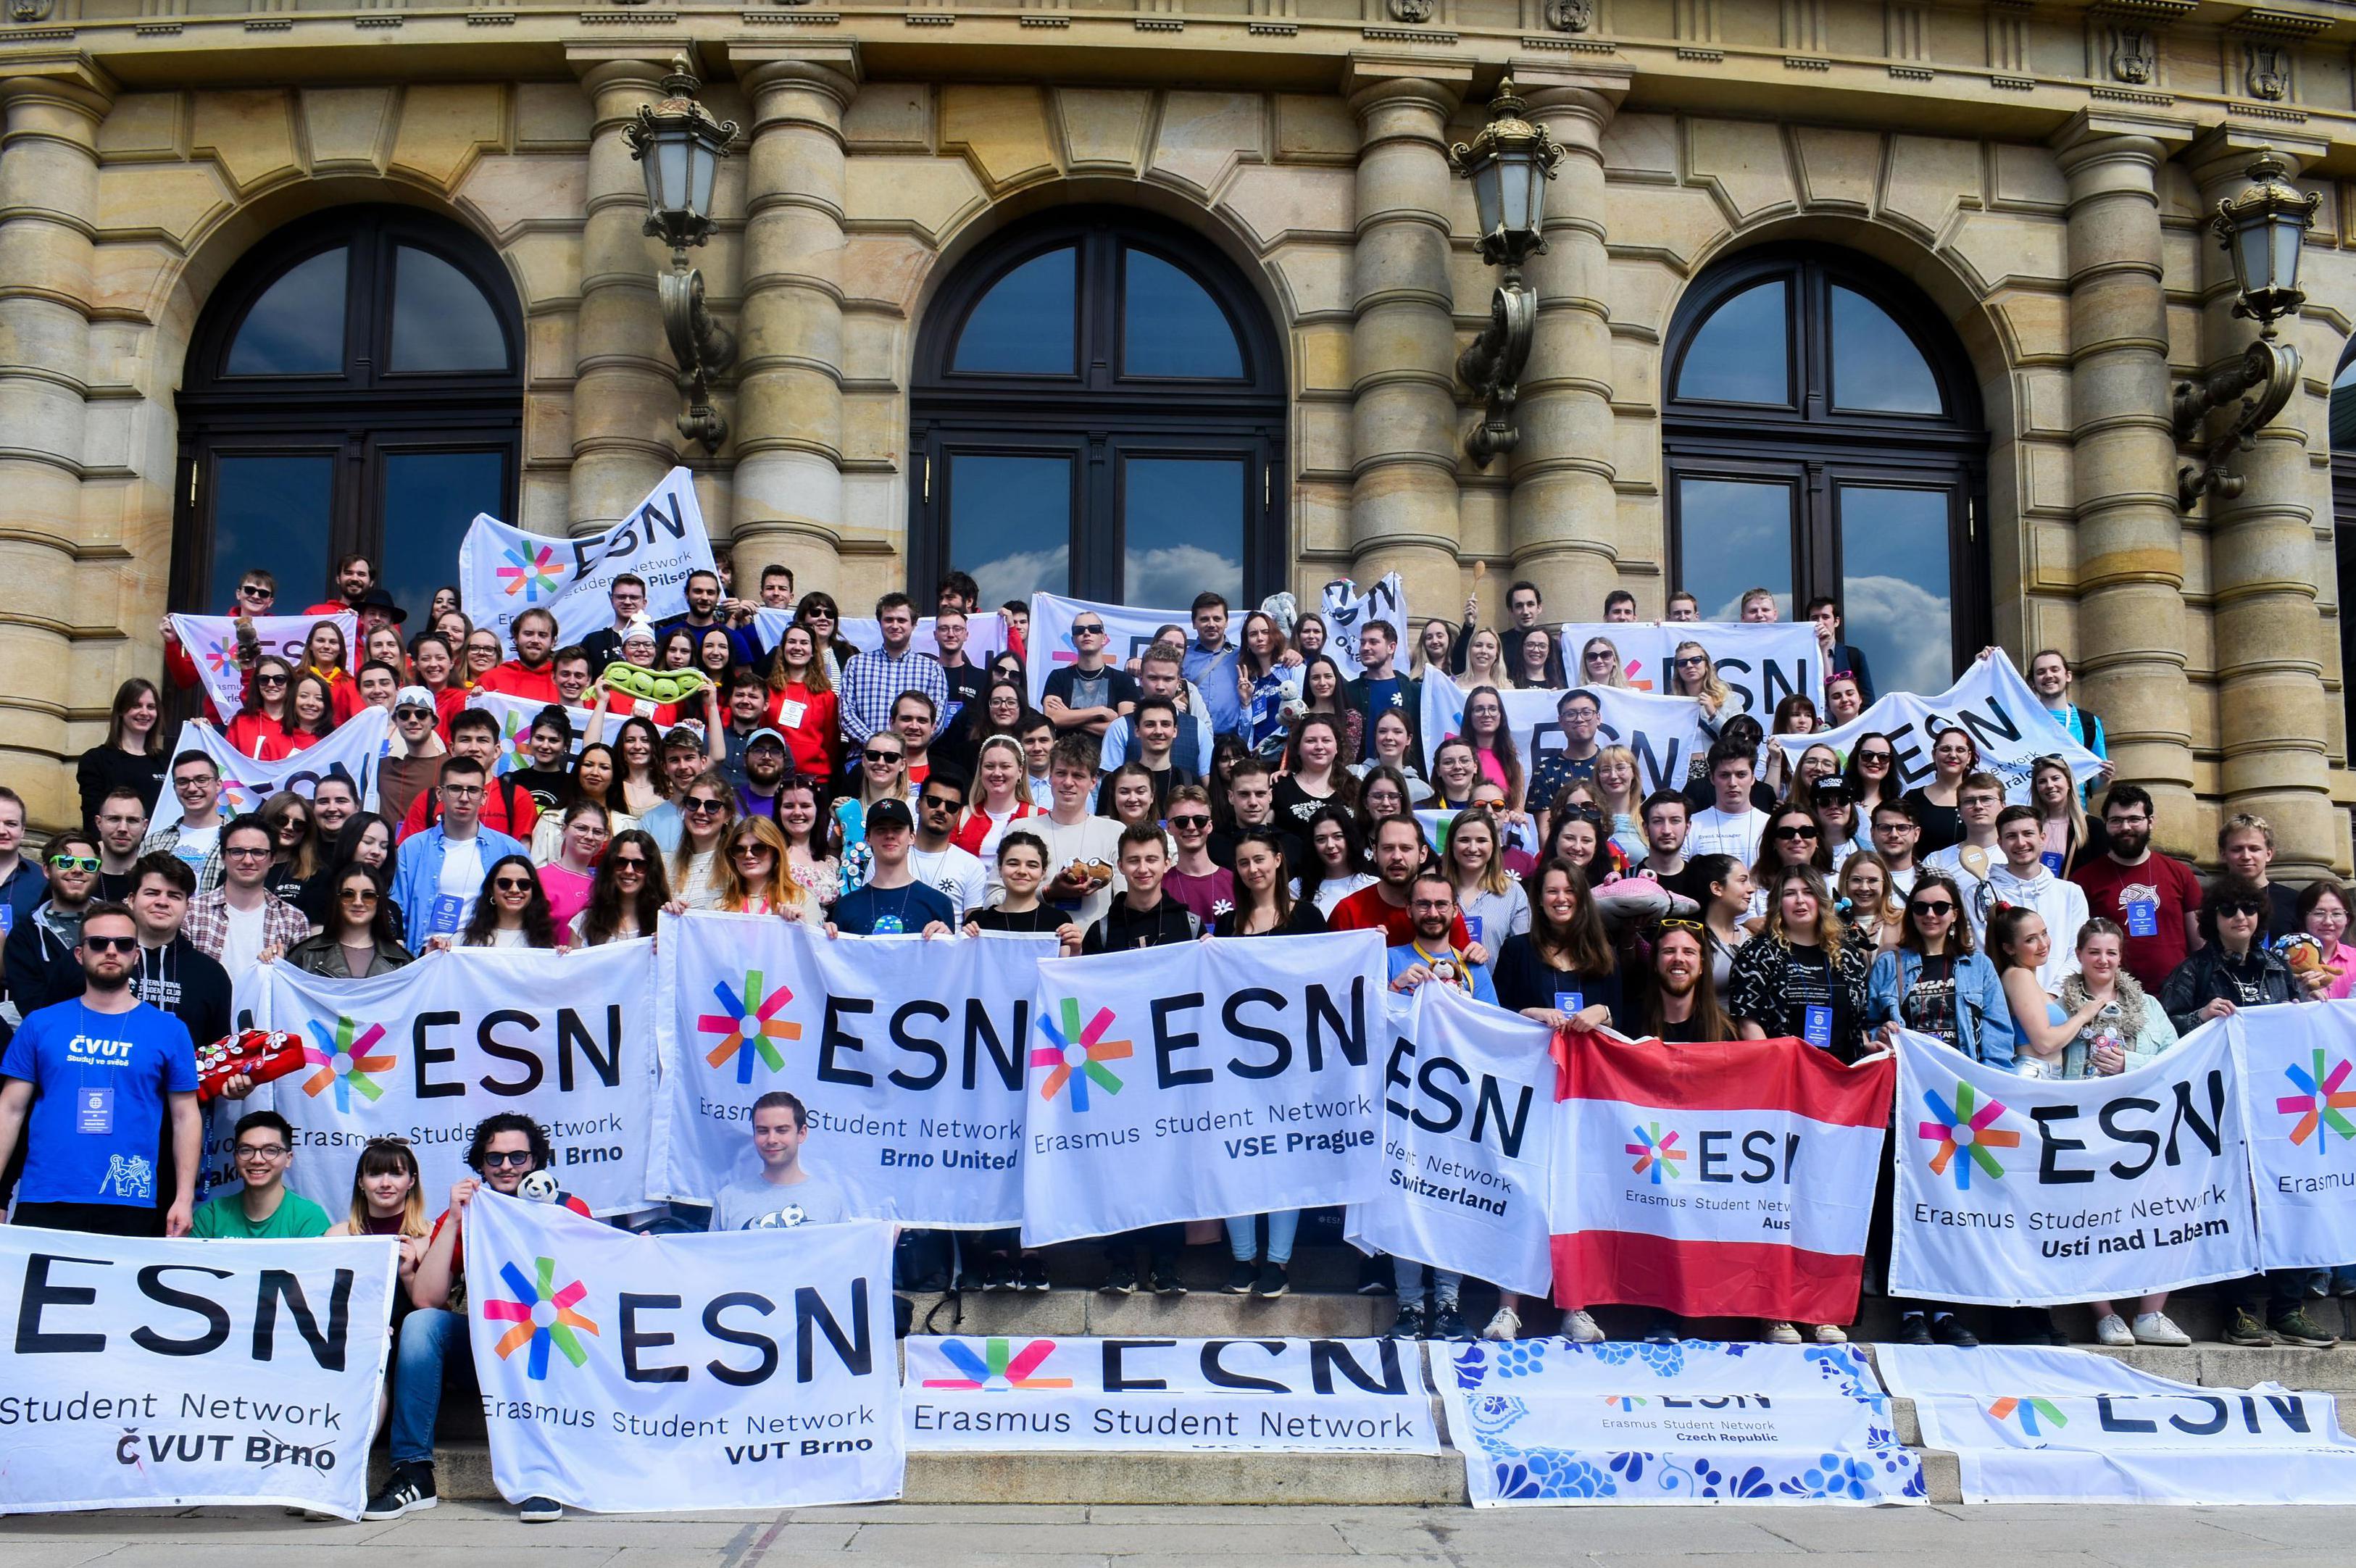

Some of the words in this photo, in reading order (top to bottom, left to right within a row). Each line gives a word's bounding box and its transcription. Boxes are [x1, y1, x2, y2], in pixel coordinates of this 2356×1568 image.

[573, 493, 686, 581] ESN
[649, 567, 695, 588] Pilsen
[1986, 750, 2043, 777] etwork
[69, 1035, 133, 1057] ČVUT
[412, 1004, 622, 1098] ESN
[817, 992, 1028, 1091] ESN
[1151, 975, 1368, 1090] ESN
[67, 1054, 94, 1065] Studuj
[1386, 1037, 1534, 1159] ESN
[544, 1113, 623, 1138] etwork
[806, 1109, 907, 1137] Student
[920, 1118, 1022, 1140] Network
[1035, 1127, 1140, 1154] Erasmus
[1155, 1107, 1254, 1138] Student
[1269, 1094, 1372, 1124] Network
[2031, 1070, 2225, 1185] ESN
[565, 1147, 623, 1167] Brno
[880, 1148, 934, 1169] Brno
[942, 1150, 1017, 1170] United
[1225, 1135, 1278, 1159] VSE
[1287, 1129, 1375, 1155] Prague
[1385, 1140, 1416, 1167] dent
[1426, 1155, 1513, 1194] Network
[2278, 1172, 2355, 1194] Erasmu
[1389, 1167, 1507, 1217] Switzerland
[1626, 1189, 1686, 1209] Erasmus
[1695, 1196, 1750, 1212] Student
[1915, 1204, 2015, 1230] Erasmus
[2028, 1206, 2122, 1232] Student
[2131, 1184, 2226, 1219] Network
[2099, 1229, 2146, 1255] nad
[2155, 1218, 2230, 1248] Labem
[14, 1253, 354, 1372] ESN
[619, 1277, 873, 1387] ESN
[0, 1390, 158, 1426] Student
[180, 1392, 341, 1431] Network
[481, 1394, 596, 1429] Erasmus
[613, 1411, 729, 1438] Student
[747, 1403, 875, 1434] Network
[914, 1403, 1071, 1434] Erasmus
[1093, 1407, 1239, 1438] Student
[1260, 1411, 1415, 1438] Network
[1602, 1418, 1657, 1429] Erasmus
[1664, 1418, 1715, 1430] Student
[1720, 1419, 1776, 1430] Network
[117, 1427, 233, 1465] ČVUT
[725, 1440, 790, 1466] VUT
[801, 1438, 873, 1456] Brno
[1676, 1432, 1717, 1443] Czech
[1720, 1433, 1779, 1443] Republic
